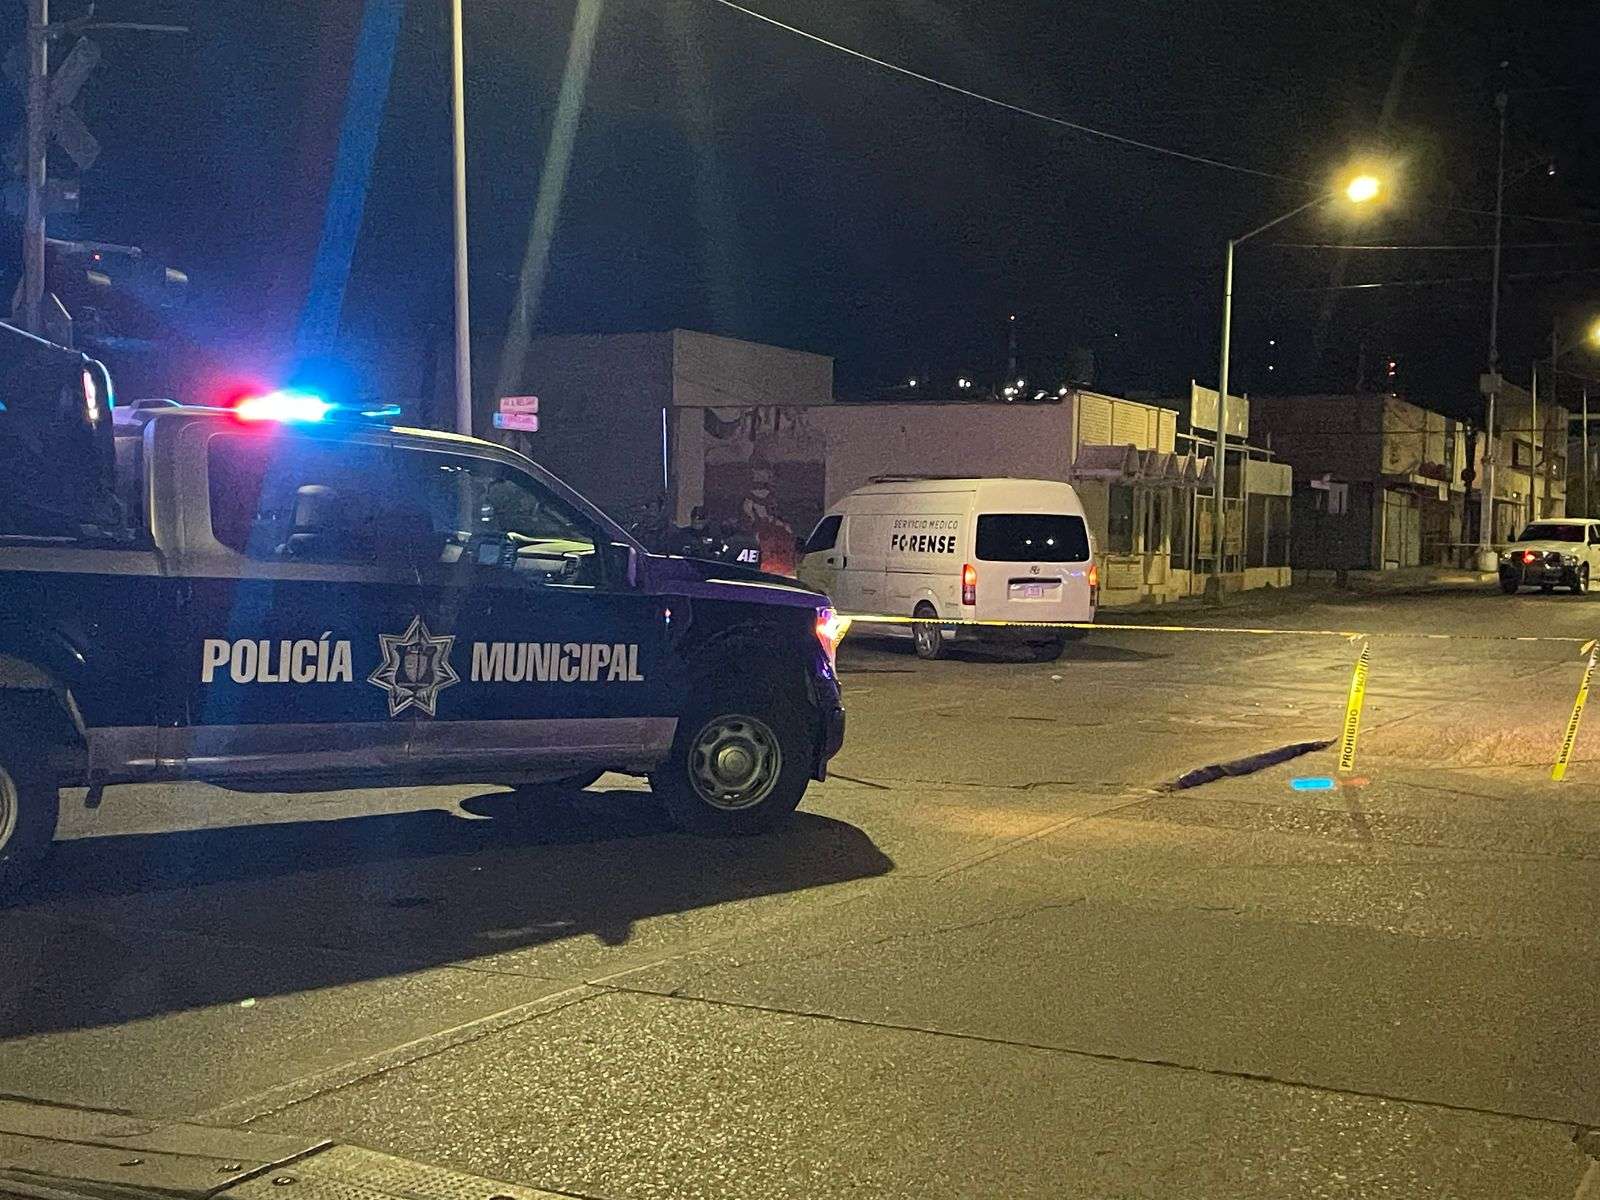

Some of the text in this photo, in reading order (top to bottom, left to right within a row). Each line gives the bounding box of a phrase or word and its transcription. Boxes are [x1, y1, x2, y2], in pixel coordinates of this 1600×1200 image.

[894, 519, 927, 529] SERVICIO
[891, 534, 956, 554] FORENSE
[202, 630, 645, 684] POLICÍA MUNICIPAL
[1341, 708, 1358, 768] PROHIBIDO
